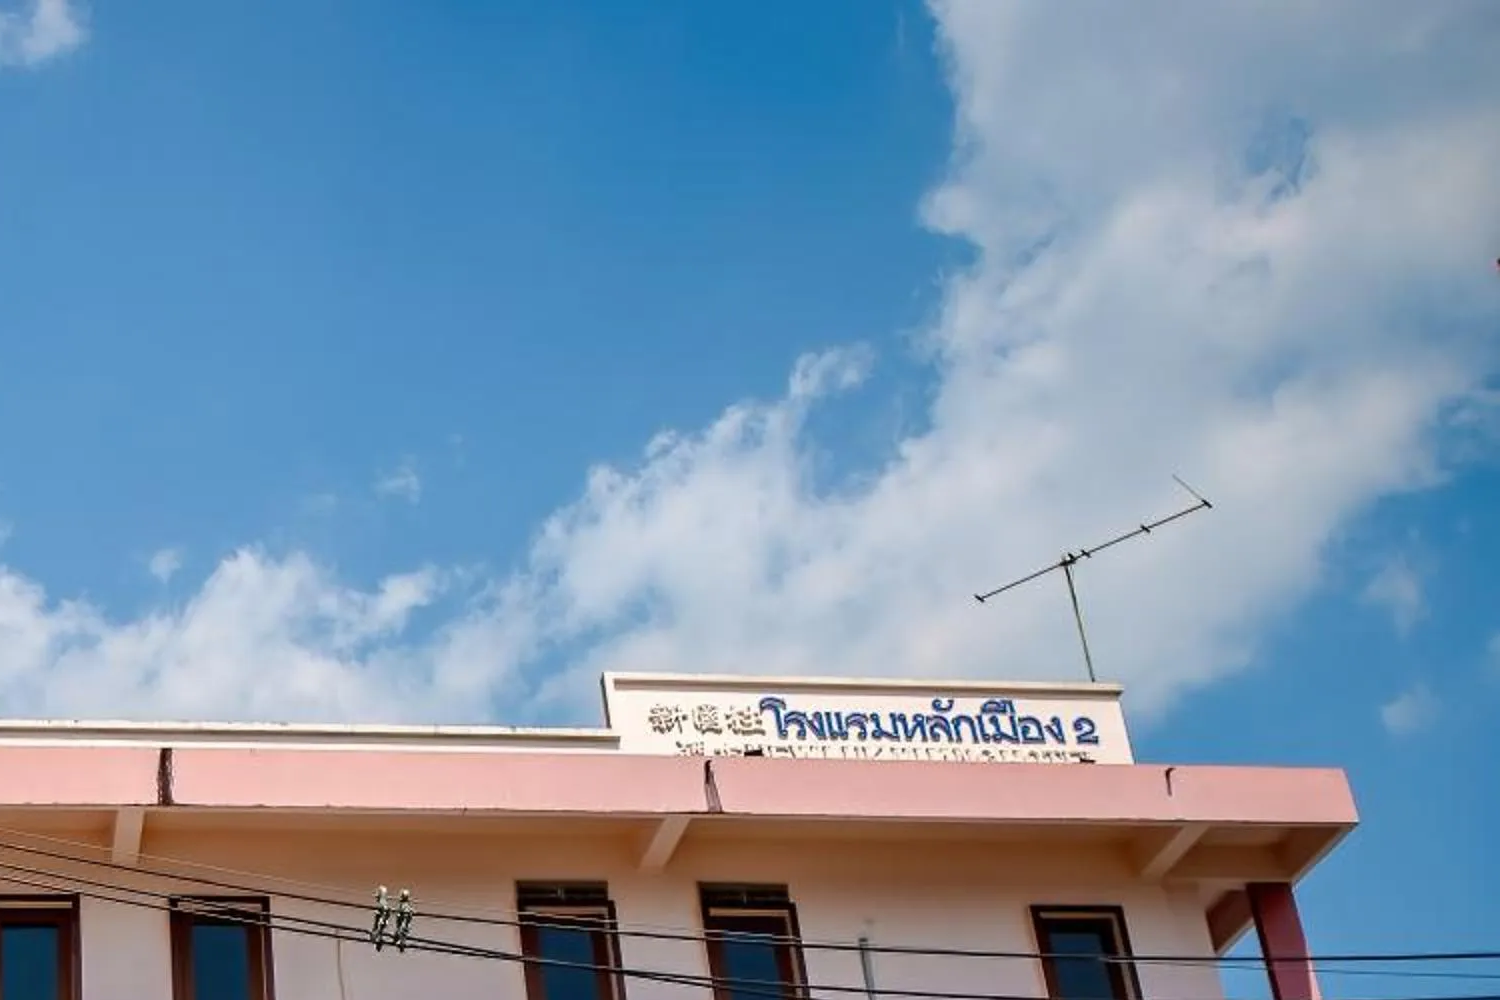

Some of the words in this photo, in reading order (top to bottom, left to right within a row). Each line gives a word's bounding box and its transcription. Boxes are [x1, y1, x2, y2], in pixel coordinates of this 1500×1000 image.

[760, 697, 1067, 744] โรงแรมหลักเมือง
[1074, 719, 1099, 745] 2
